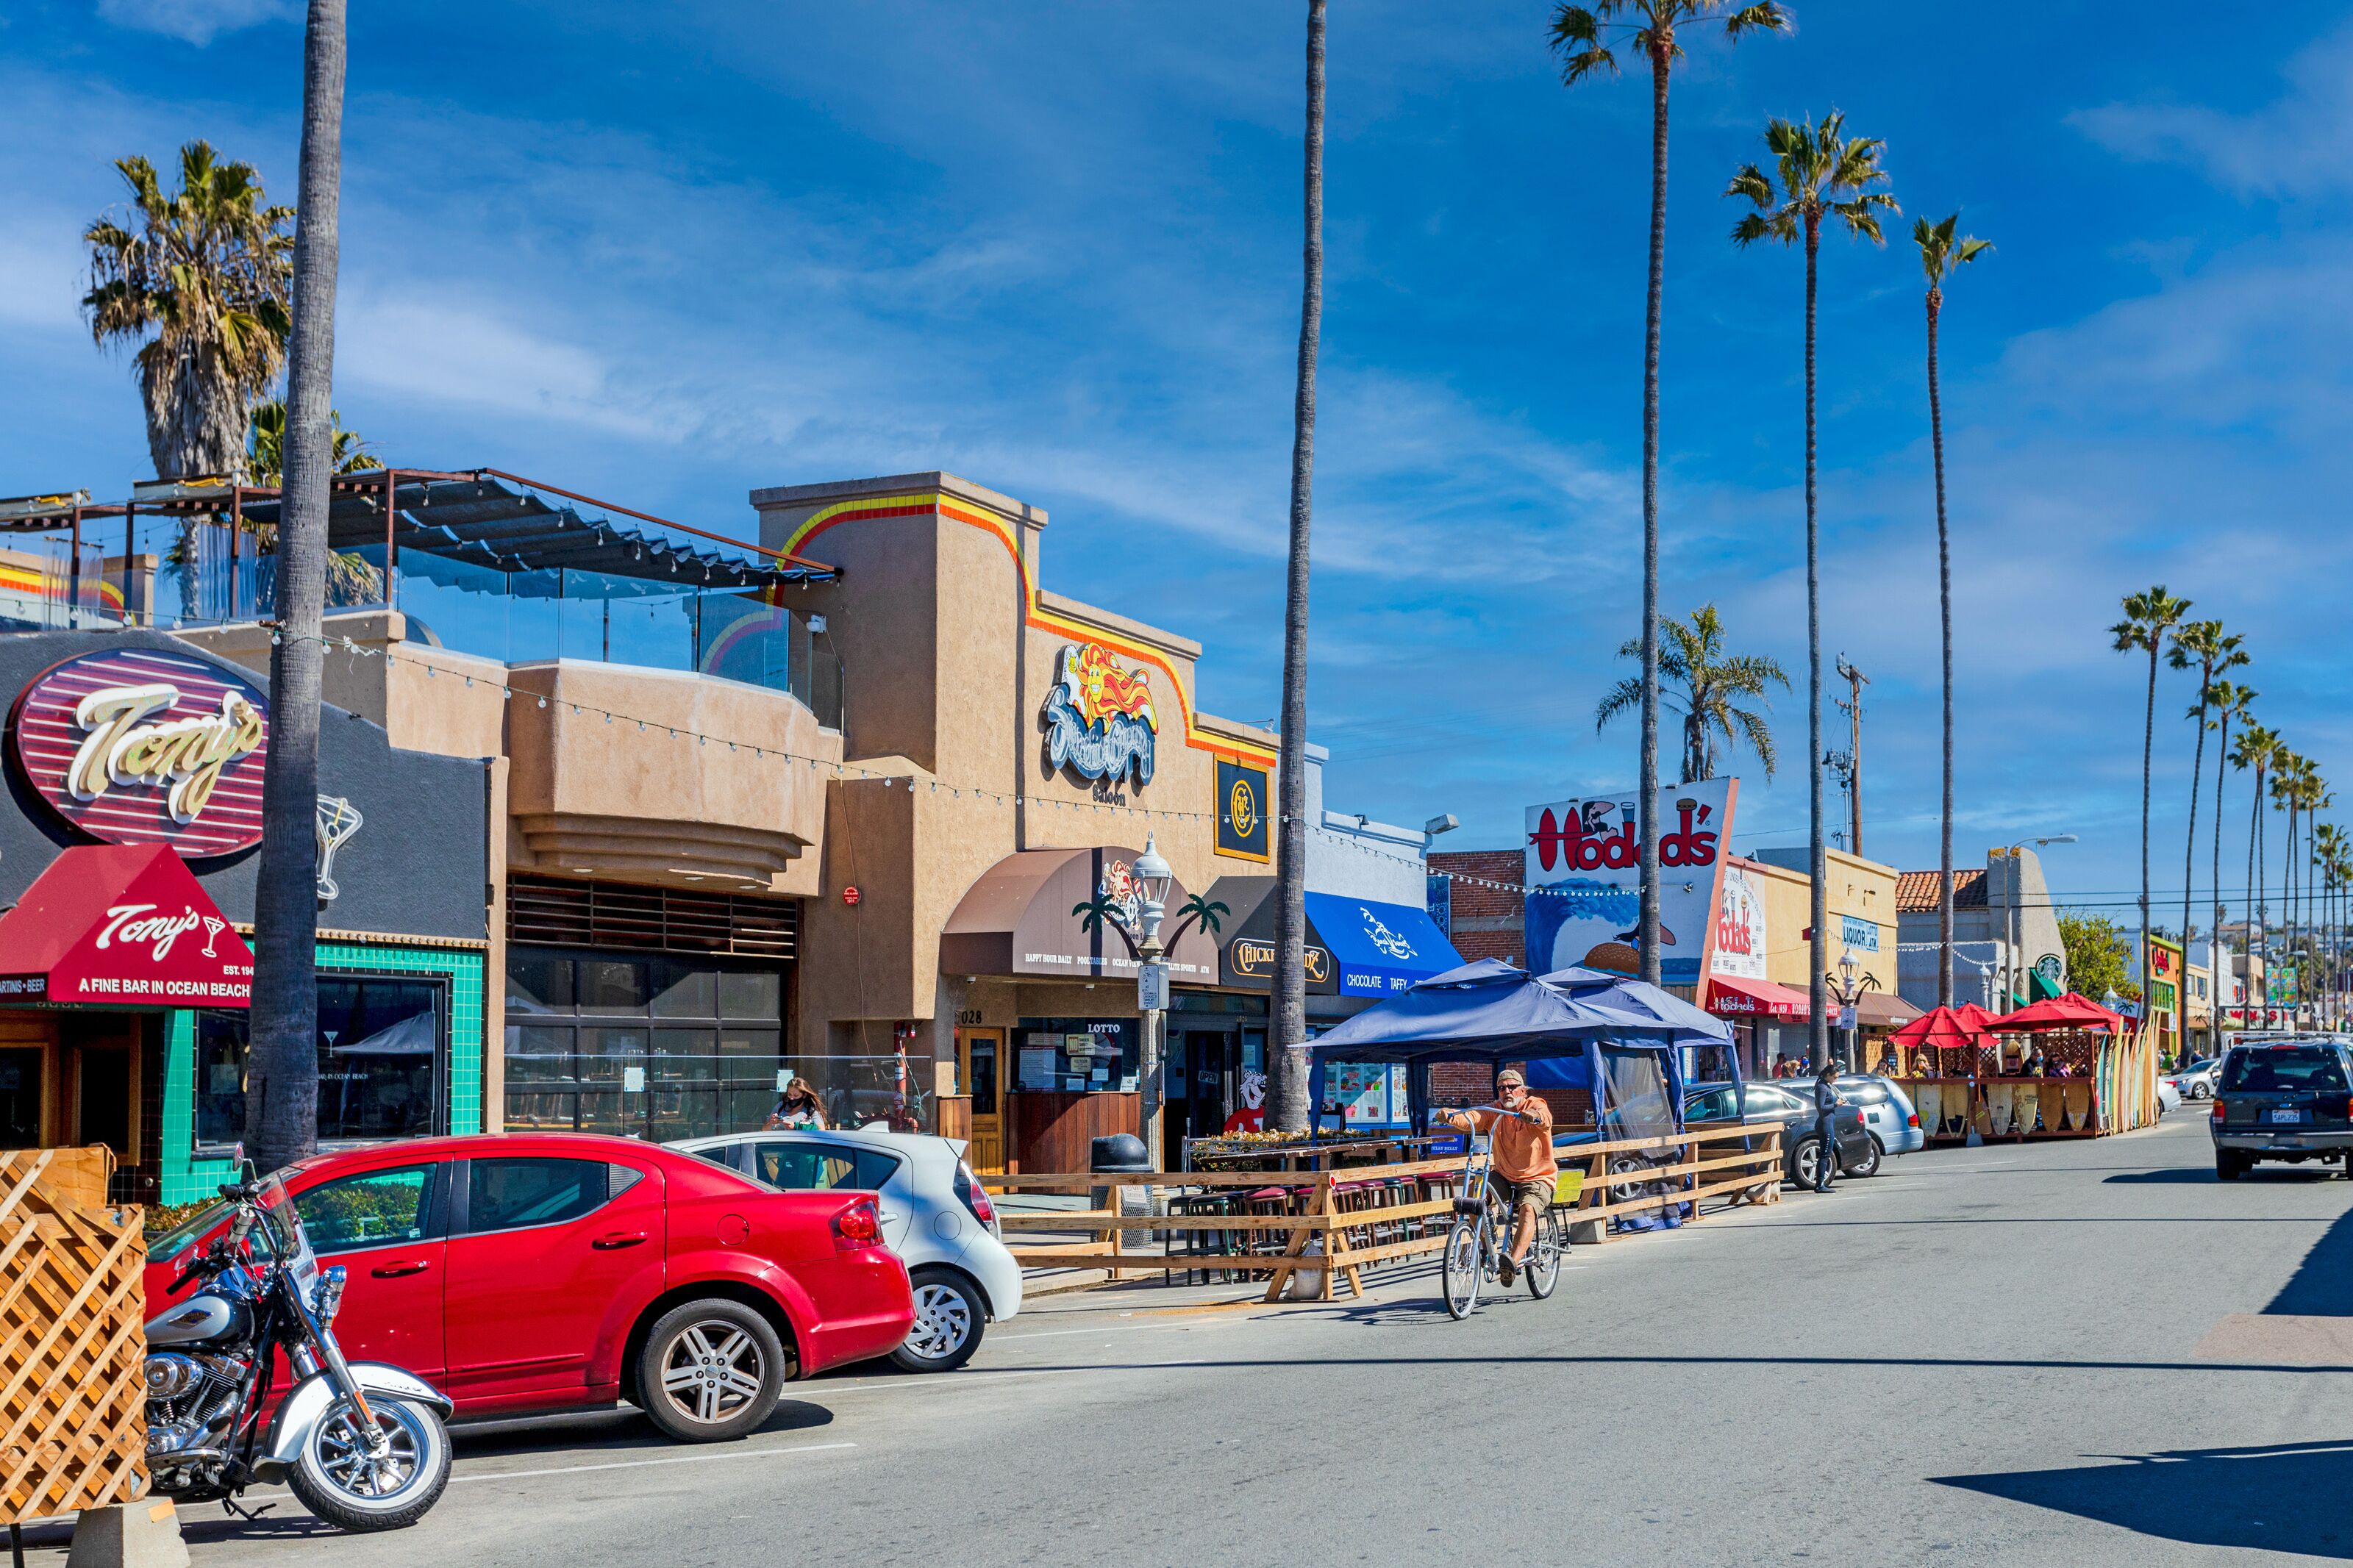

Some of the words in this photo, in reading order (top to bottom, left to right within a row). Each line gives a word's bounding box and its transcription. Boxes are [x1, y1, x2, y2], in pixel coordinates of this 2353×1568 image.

[68, 684, 263, 824] Tony's
[1093, 784, 1126, 806] Saloon
[1529, 803, 1718, 872] Hodd's
[96, 904, 199, 962] Tony's
[1843, 926, 1865, 946] LIQUOR
[223, 964, 240, 976] EST.
[241, 966, 254, 975] 194
[1025, 953, 1043, 962] HAPPY
[1043, 954, 1057, 963] HOUR
[1057, 955, 1072, 964] DAILY
[1077, 956, 1090, 965] POOL
[1090, 957, 1107, 965] TABLES
[1112, 958, 1129, 967] OCEAN
[1180, 964, 1196, 973] SPORTS
[1200, 965, 1210, 974] ATM
[1238, 942, 1275, 973] CHICKE
[1304, 950, 1324, 979] DZ
[27, 978, 45, 992] BEER
[79, 978, 89, 992] A
[91, 978, 120, 993] FINE
[123, 980, 149, 994] BAR
[151, 981, 164, 994] IN
[166, 981, 208, 996] OCEAN
[210, 982, 250, 998] BEACH
[1347, 974, 1381, 988] CHOCOLATE
[1390, 978, 1407, 990] TAFFY
[2229, 1010, 2278, 1022] WNS
[1088, 1024, 1120, 1033] LOTTO
[1199, 1072, 1217, 1083] OPEN
